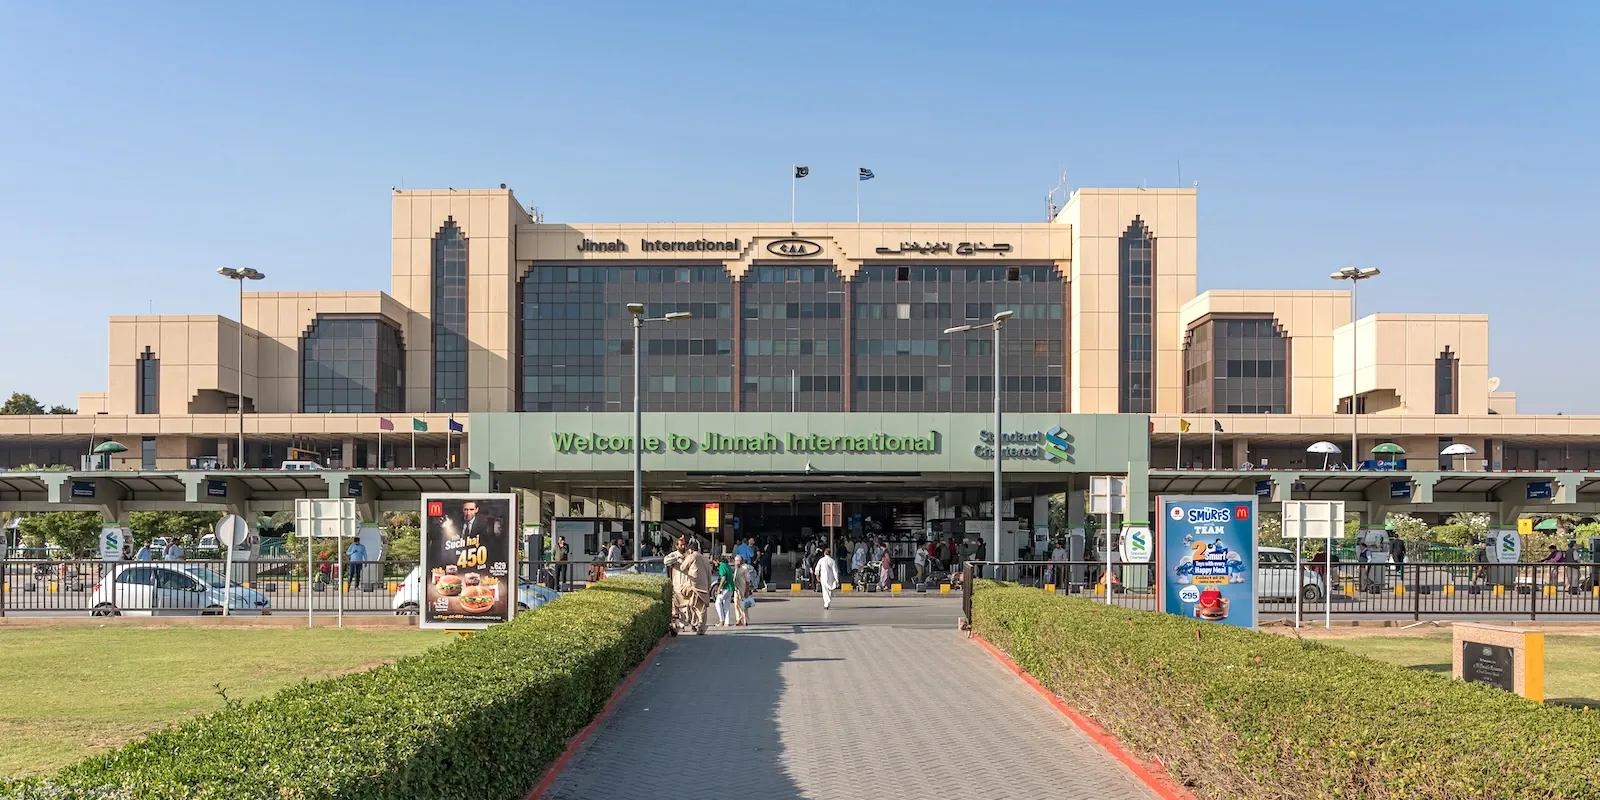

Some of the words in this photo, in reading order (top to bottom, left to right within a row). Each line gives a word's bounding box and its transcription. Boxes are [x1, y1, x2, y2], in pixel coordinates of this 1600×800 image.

[577, 238, 626, 252] Jinnah
[641, 237, 740, 252] International
[779, 244, 806, 253] CAA
[551, 431, 659, 451] Welcome
[668, 432, 691, 451] to
[698, 431, 778, 451] Jinnah
[786, 430, 935, 451] International
[979, 429, 1040, 443] Stndard
[1189, 509, 1229, 522] SMURFS
[1194, 526, 1225, 535] TEAM
[445, 538, 465, 550] Such
[457, 546, 487, 568] 450
[1191, 541, 1207, 561] 2
[1205, 551, 1226, 561] Smurf
[1195, 566, 1213, 575] Happy
[1213, 566, 1226, 574] Meal
[1182, 592, 1198, 600] 295
